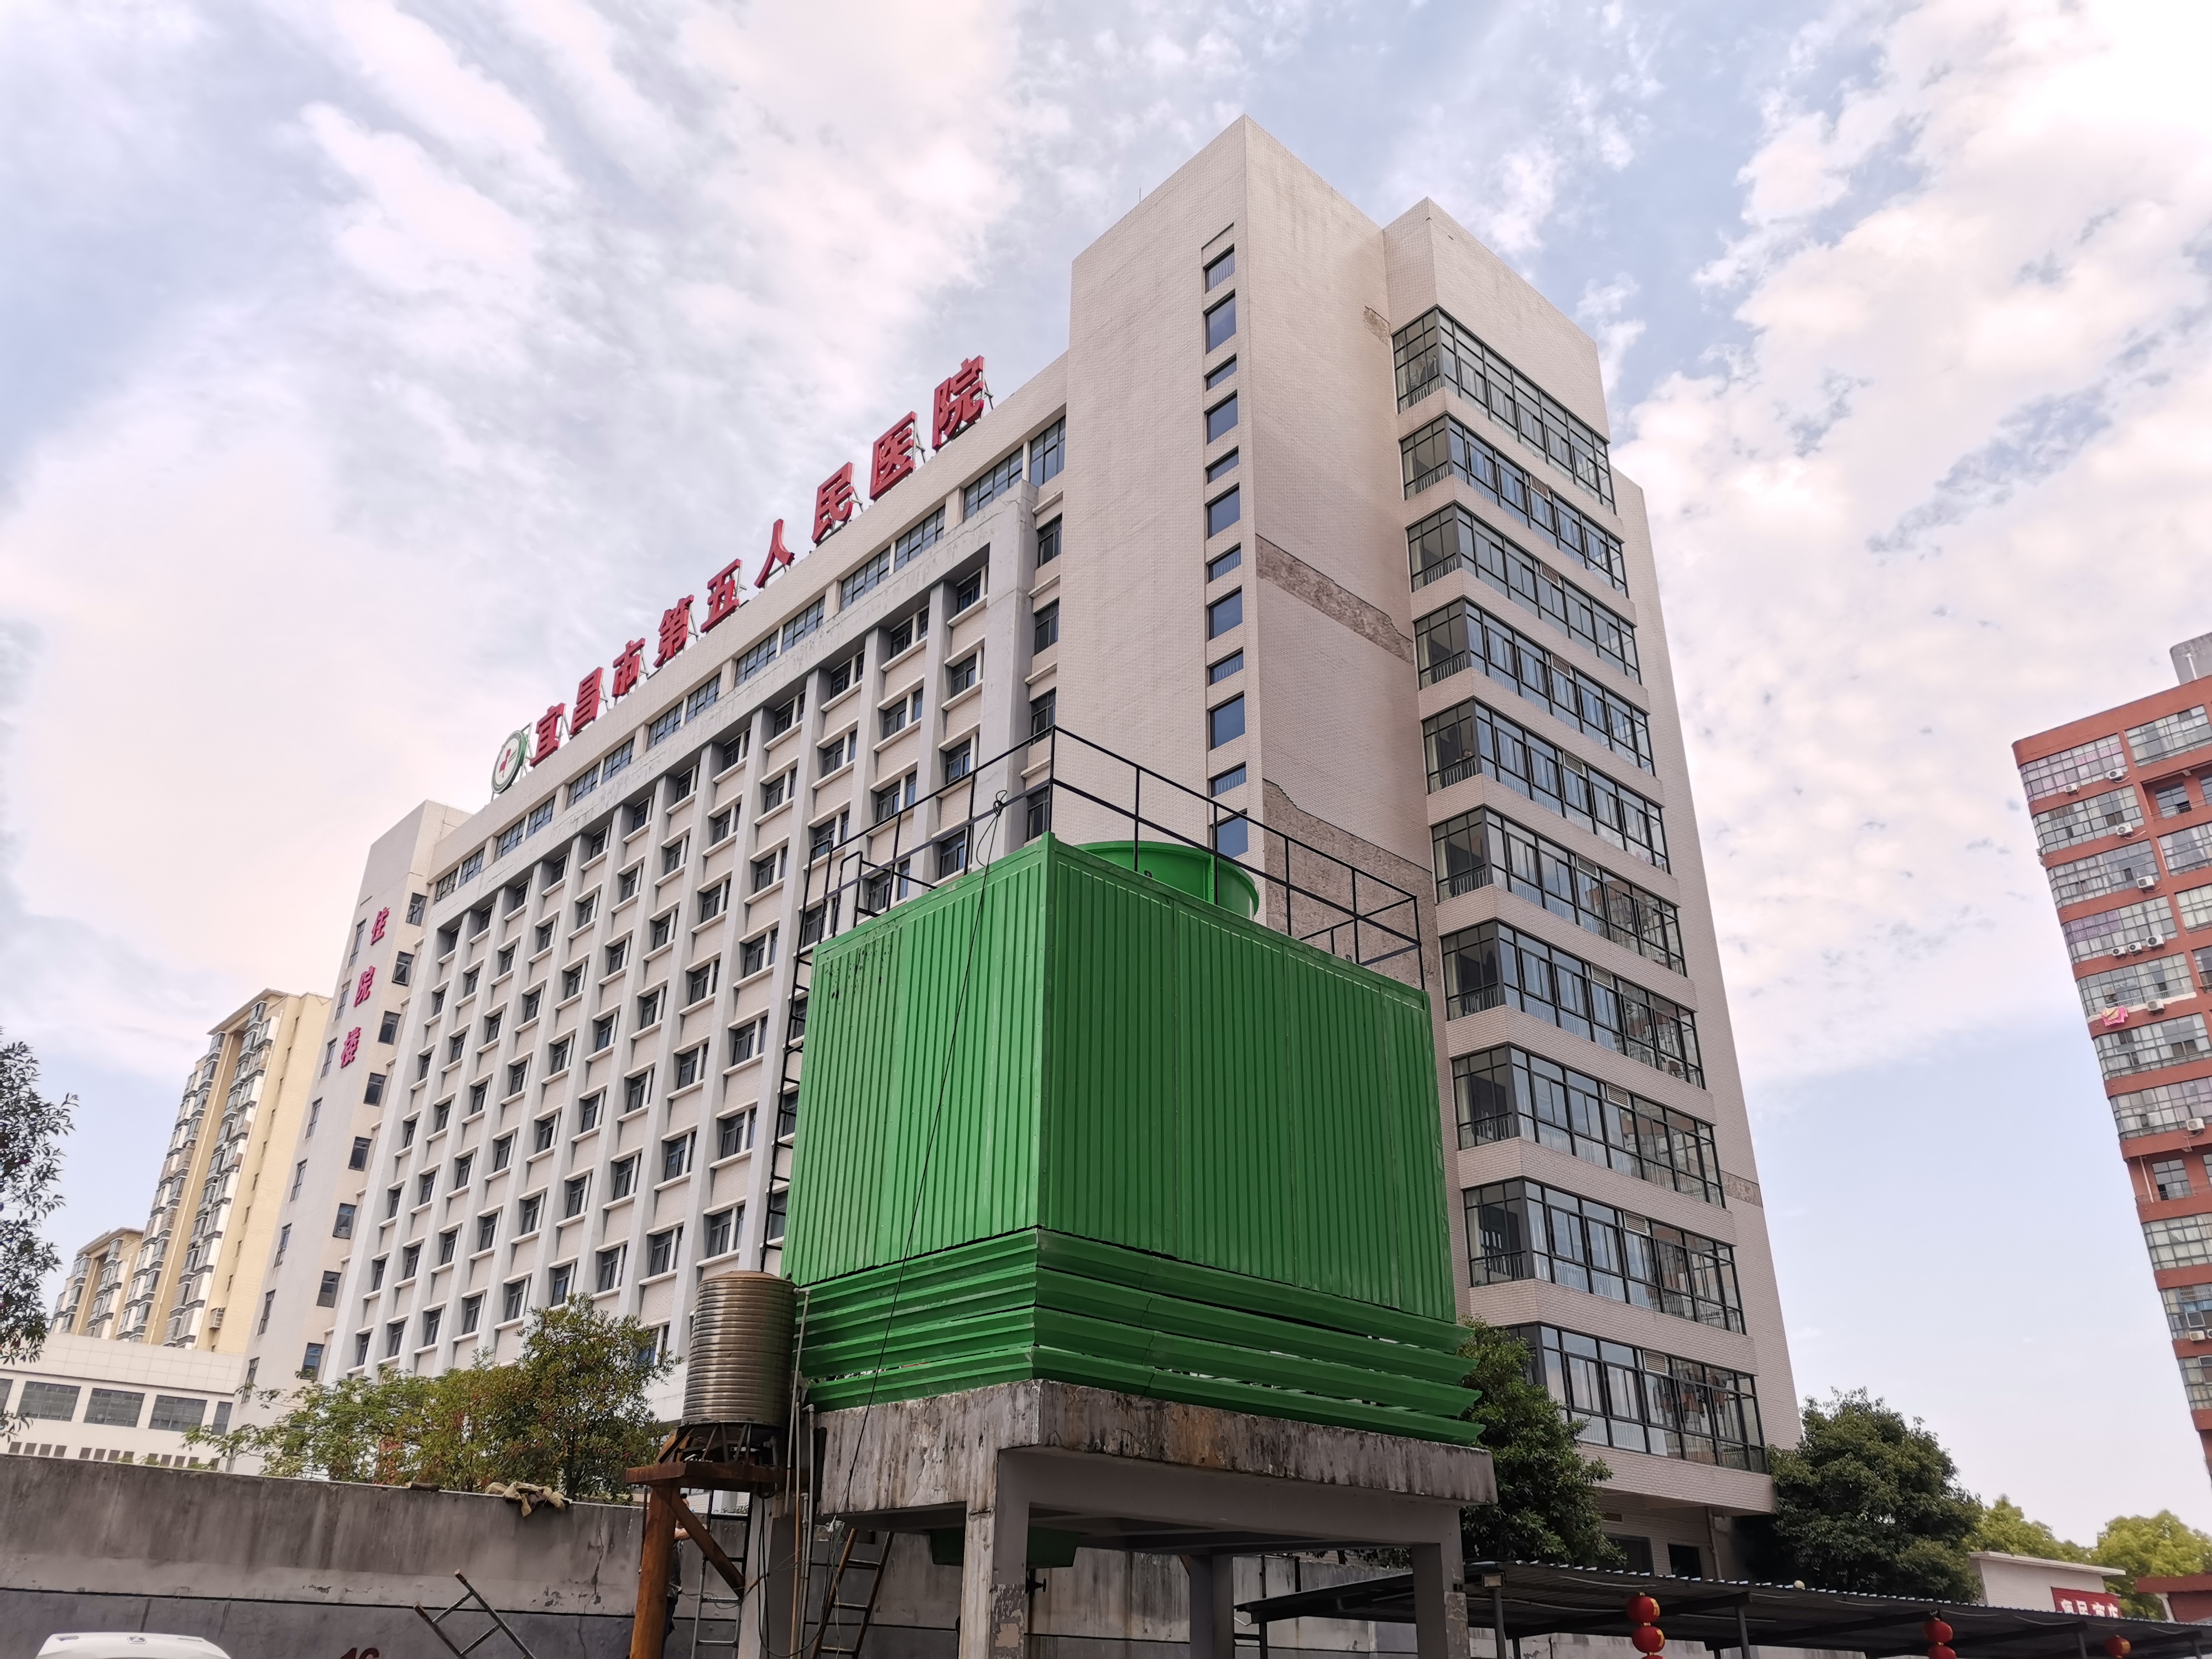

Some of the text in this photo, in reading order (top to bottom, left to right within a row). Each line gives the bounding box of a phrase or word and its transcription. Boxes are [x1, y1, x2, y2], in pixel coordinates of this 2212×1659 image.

[529, 354, 984, 767] 宜昌市第五人民医院
[340, 907, 389, 1068] 住院楼
